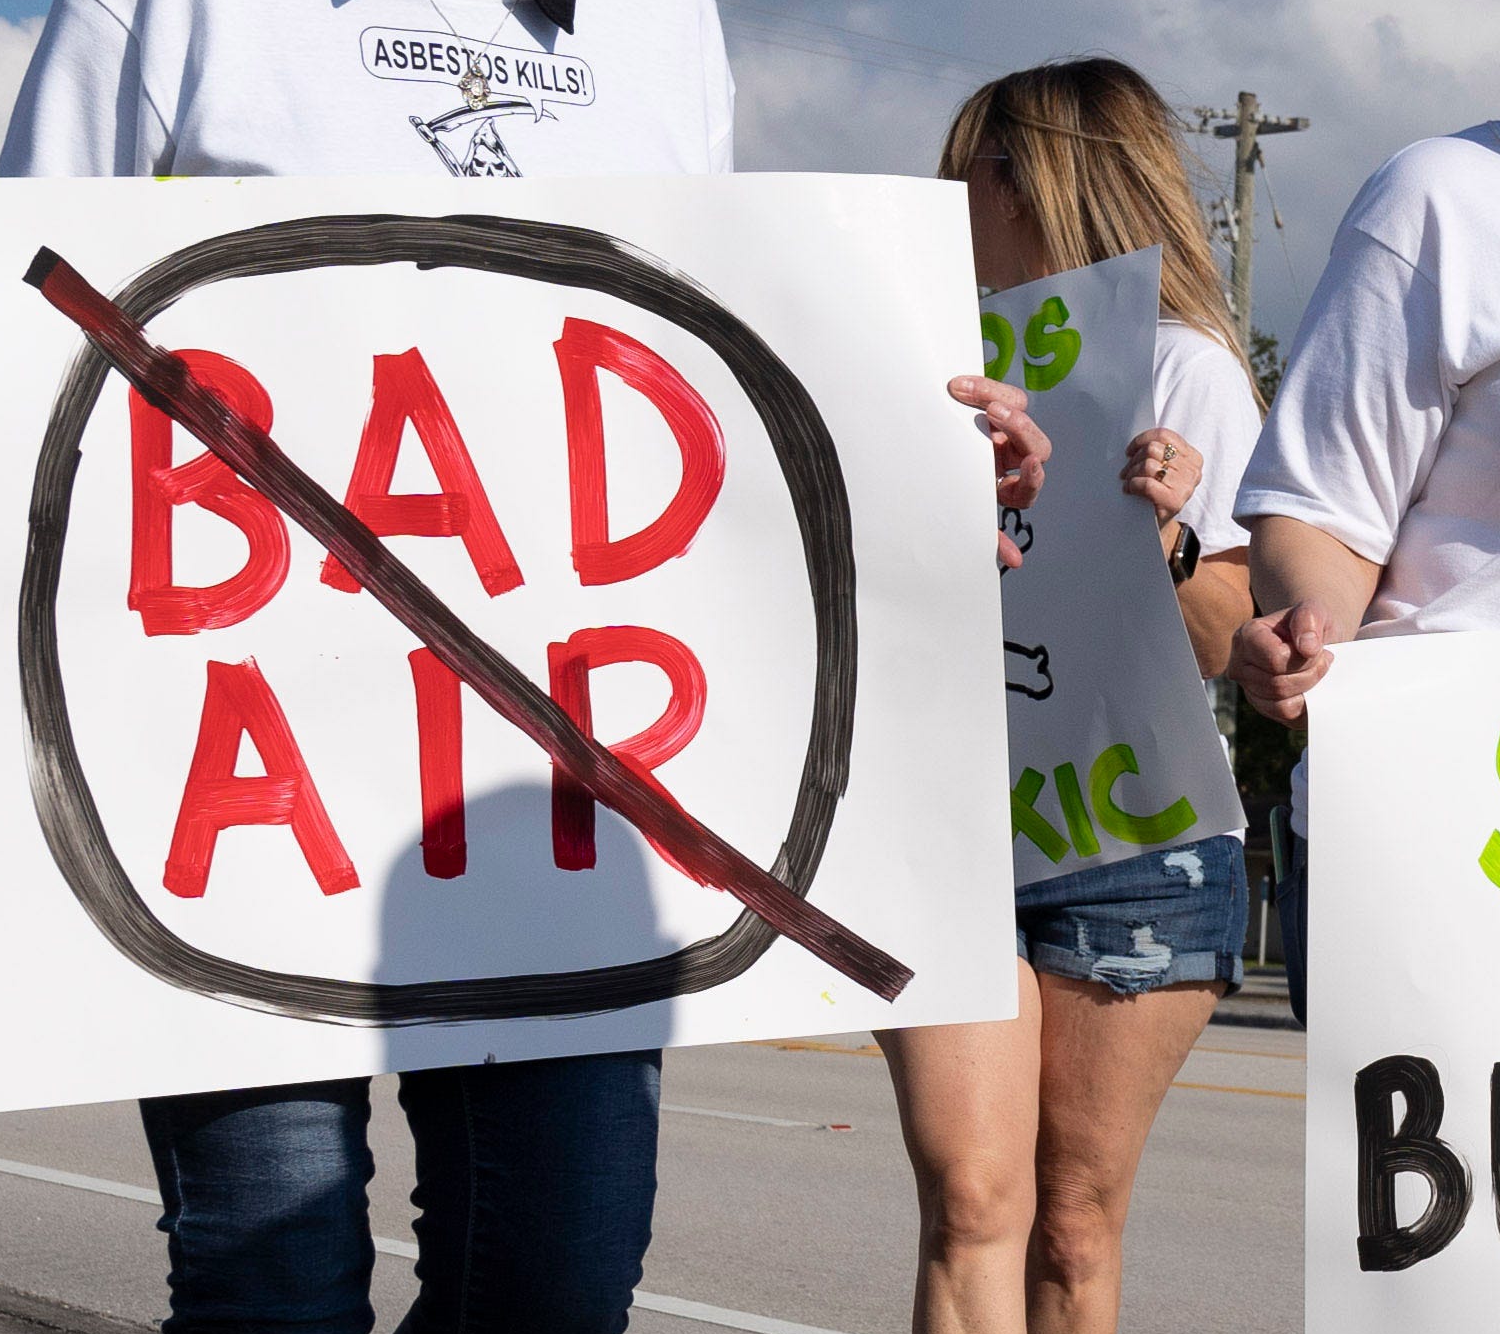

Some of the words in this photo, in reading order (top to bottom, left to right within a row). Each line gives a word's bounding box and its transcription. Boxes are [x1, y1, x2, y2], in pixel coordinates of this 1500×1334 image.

[515, 59, 587, 96] KILLS!
[127, 315, 726, 638] BAD
[162, 624, 726, 899] AIR
